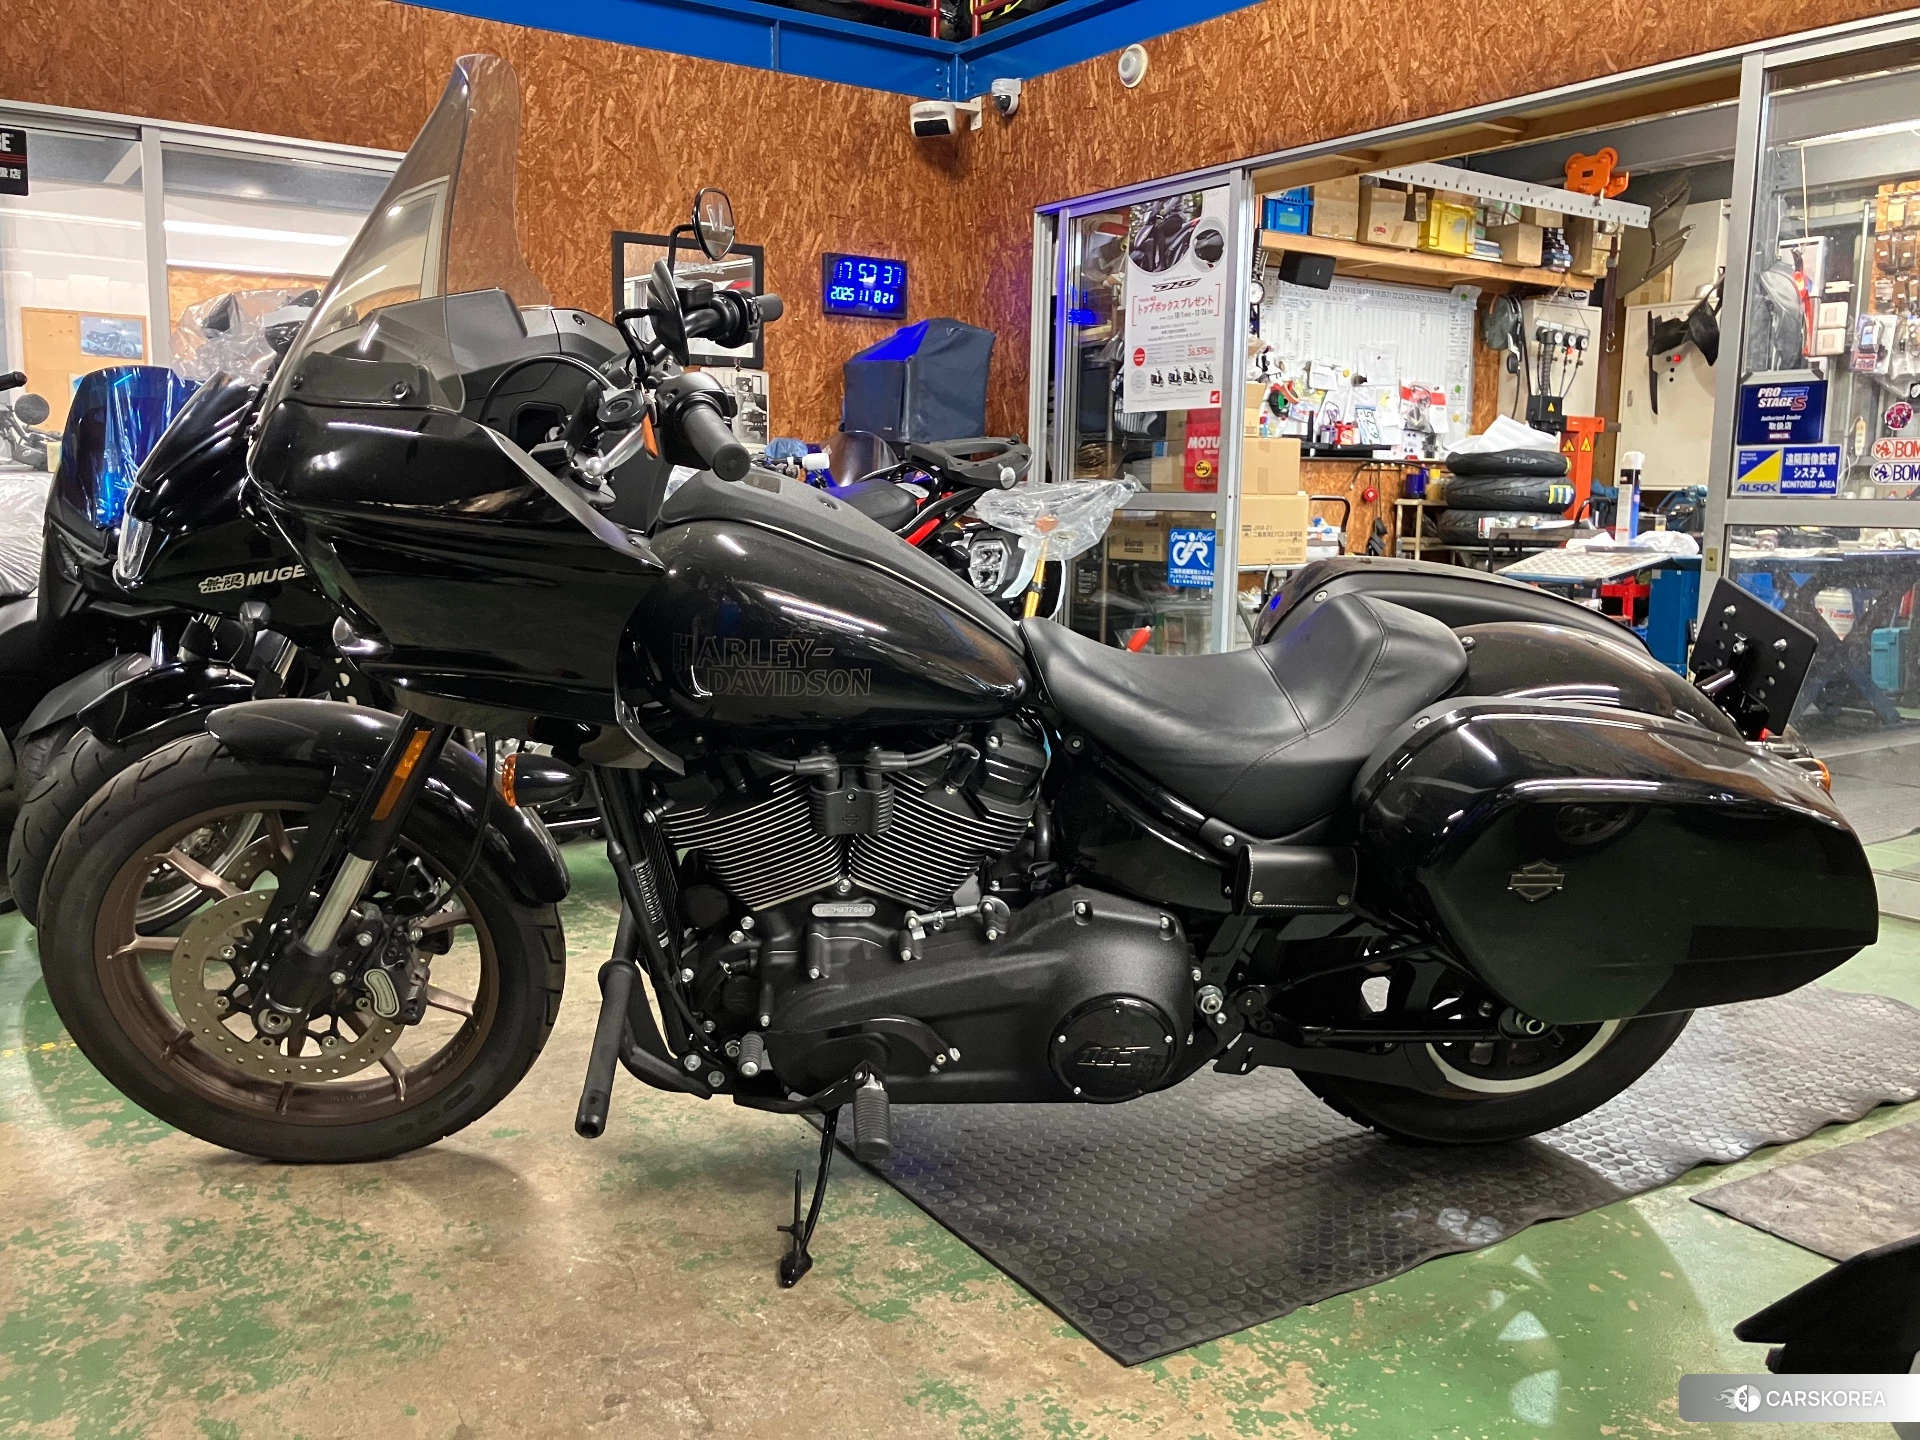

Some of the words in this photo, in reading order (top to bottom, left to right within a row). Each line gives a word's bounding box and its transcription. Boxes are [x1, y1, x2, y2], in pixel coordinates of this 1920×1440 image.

[830, 286, 855, 301] 2025
[1757, 387, 1782, 398] PRO
[1757, 397, 1793, 408] STAGE
[1187, 436, 1220, 449] MOTU
[1793, 466, 1826, 479] システム
[1736, 483, 1777, 492] ALSOK
[1781, 480, 1817, 488] MONITORED
[1818, 480, 1836, 488] AREA
[245, 564, 307, 586] MUGE
[672, 632, 835, 671] HARLEY-
[706, 667, 872, 697] DAVIDSON
